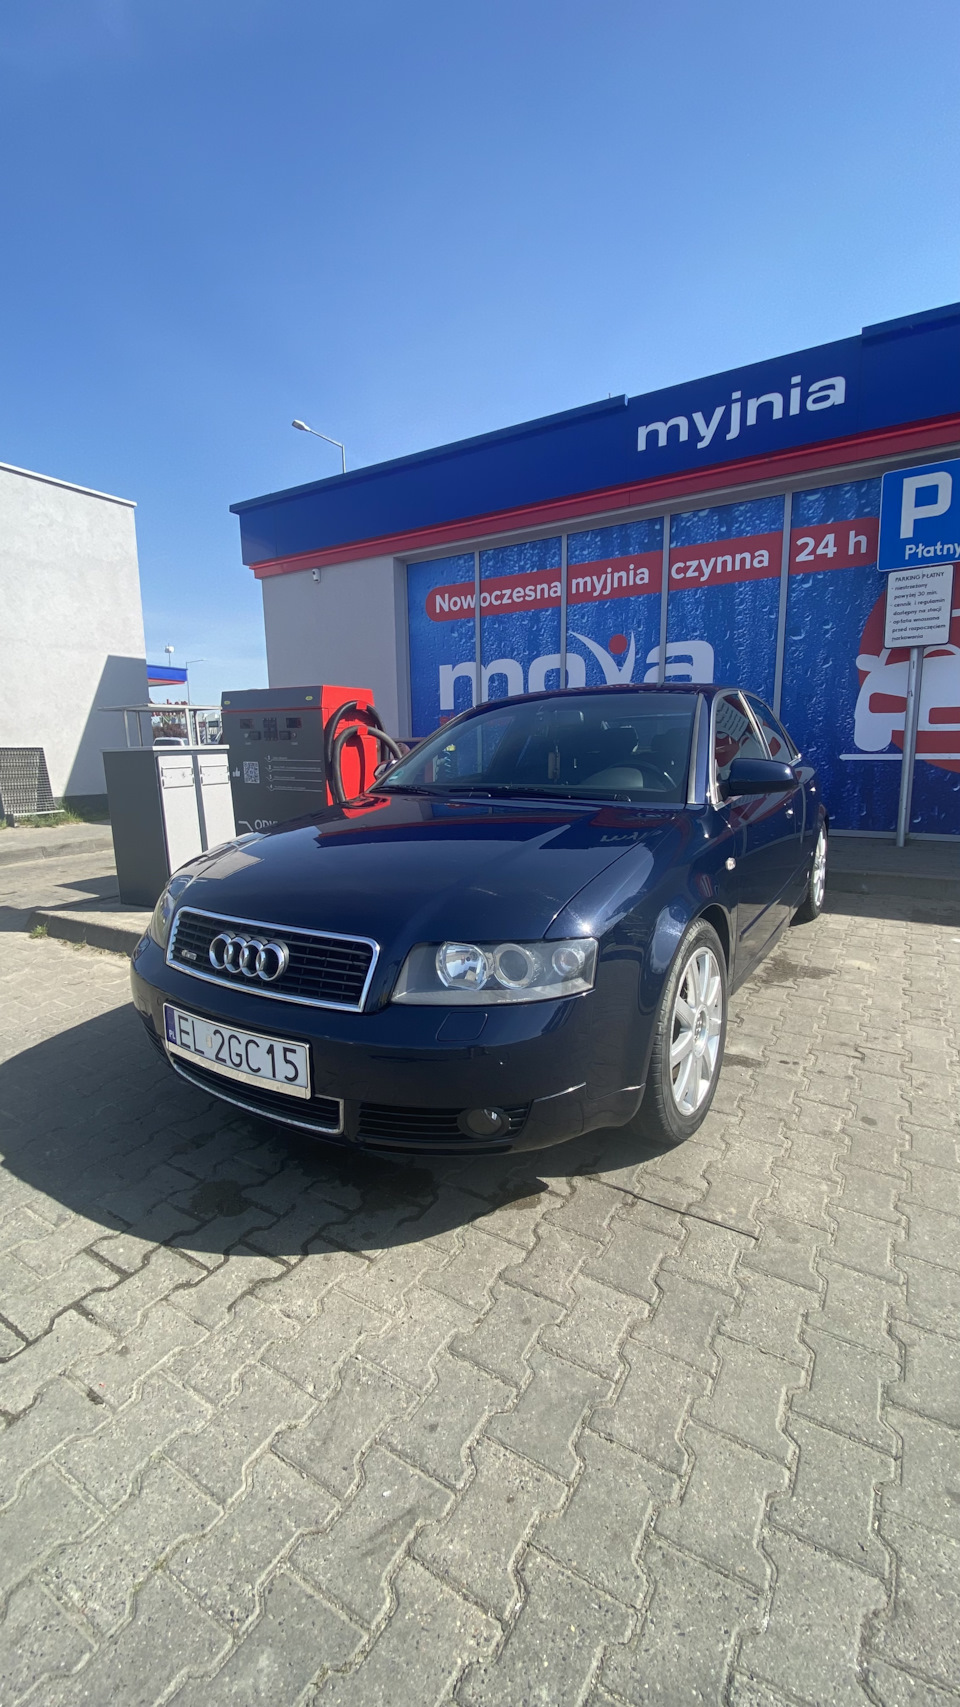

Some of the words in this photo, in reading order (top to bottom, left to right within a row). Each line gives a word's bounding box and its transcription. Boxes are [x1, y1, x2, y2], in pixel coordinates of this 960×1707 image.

[638, 375, 846, 452] myjnia
[900, 471, 953, 539] P
[435, 580, 562, 613] Nowoczesna
[571, 564, 649, 597] myjnia
[671, 549, 770, 582] czynna
[795, 533, 837, 562] 24
[848, 530, 867, 555] h
[905, 541, 960, 560] Płatny
[917, 598, 945, 606] regulamin
[169, 1029, 176, 1040] PL
[178, 1014, 205, 1055] EL
[213, 1029, 299, 1083] 2GC15
